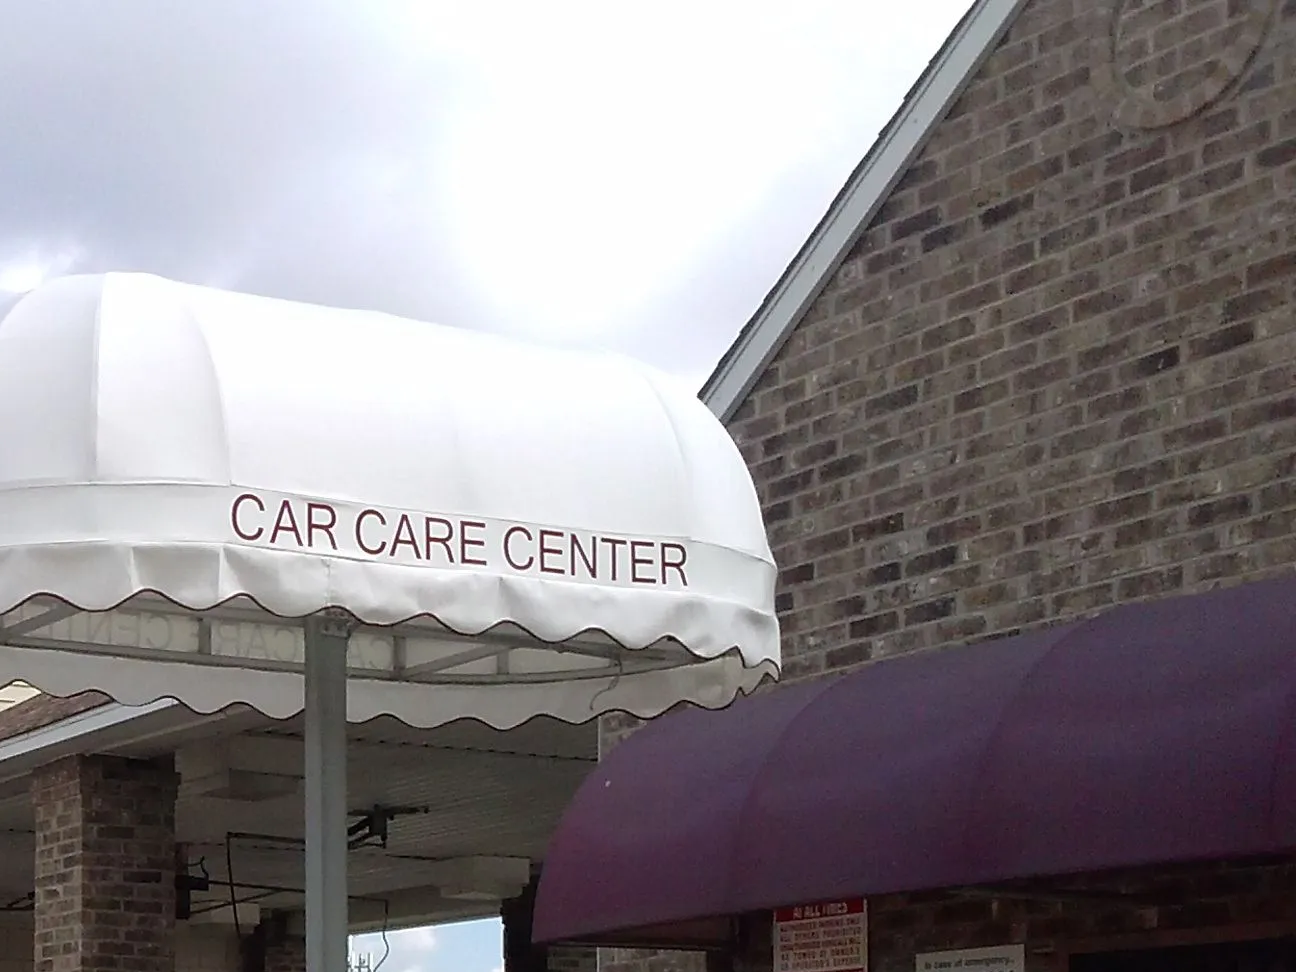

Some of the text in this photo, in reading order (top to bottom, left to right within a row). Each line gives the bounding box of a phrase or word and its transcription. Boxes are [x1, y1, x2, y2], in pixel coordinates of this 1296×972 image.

[230, 493, 689, 587] CAR CARE CENTER
